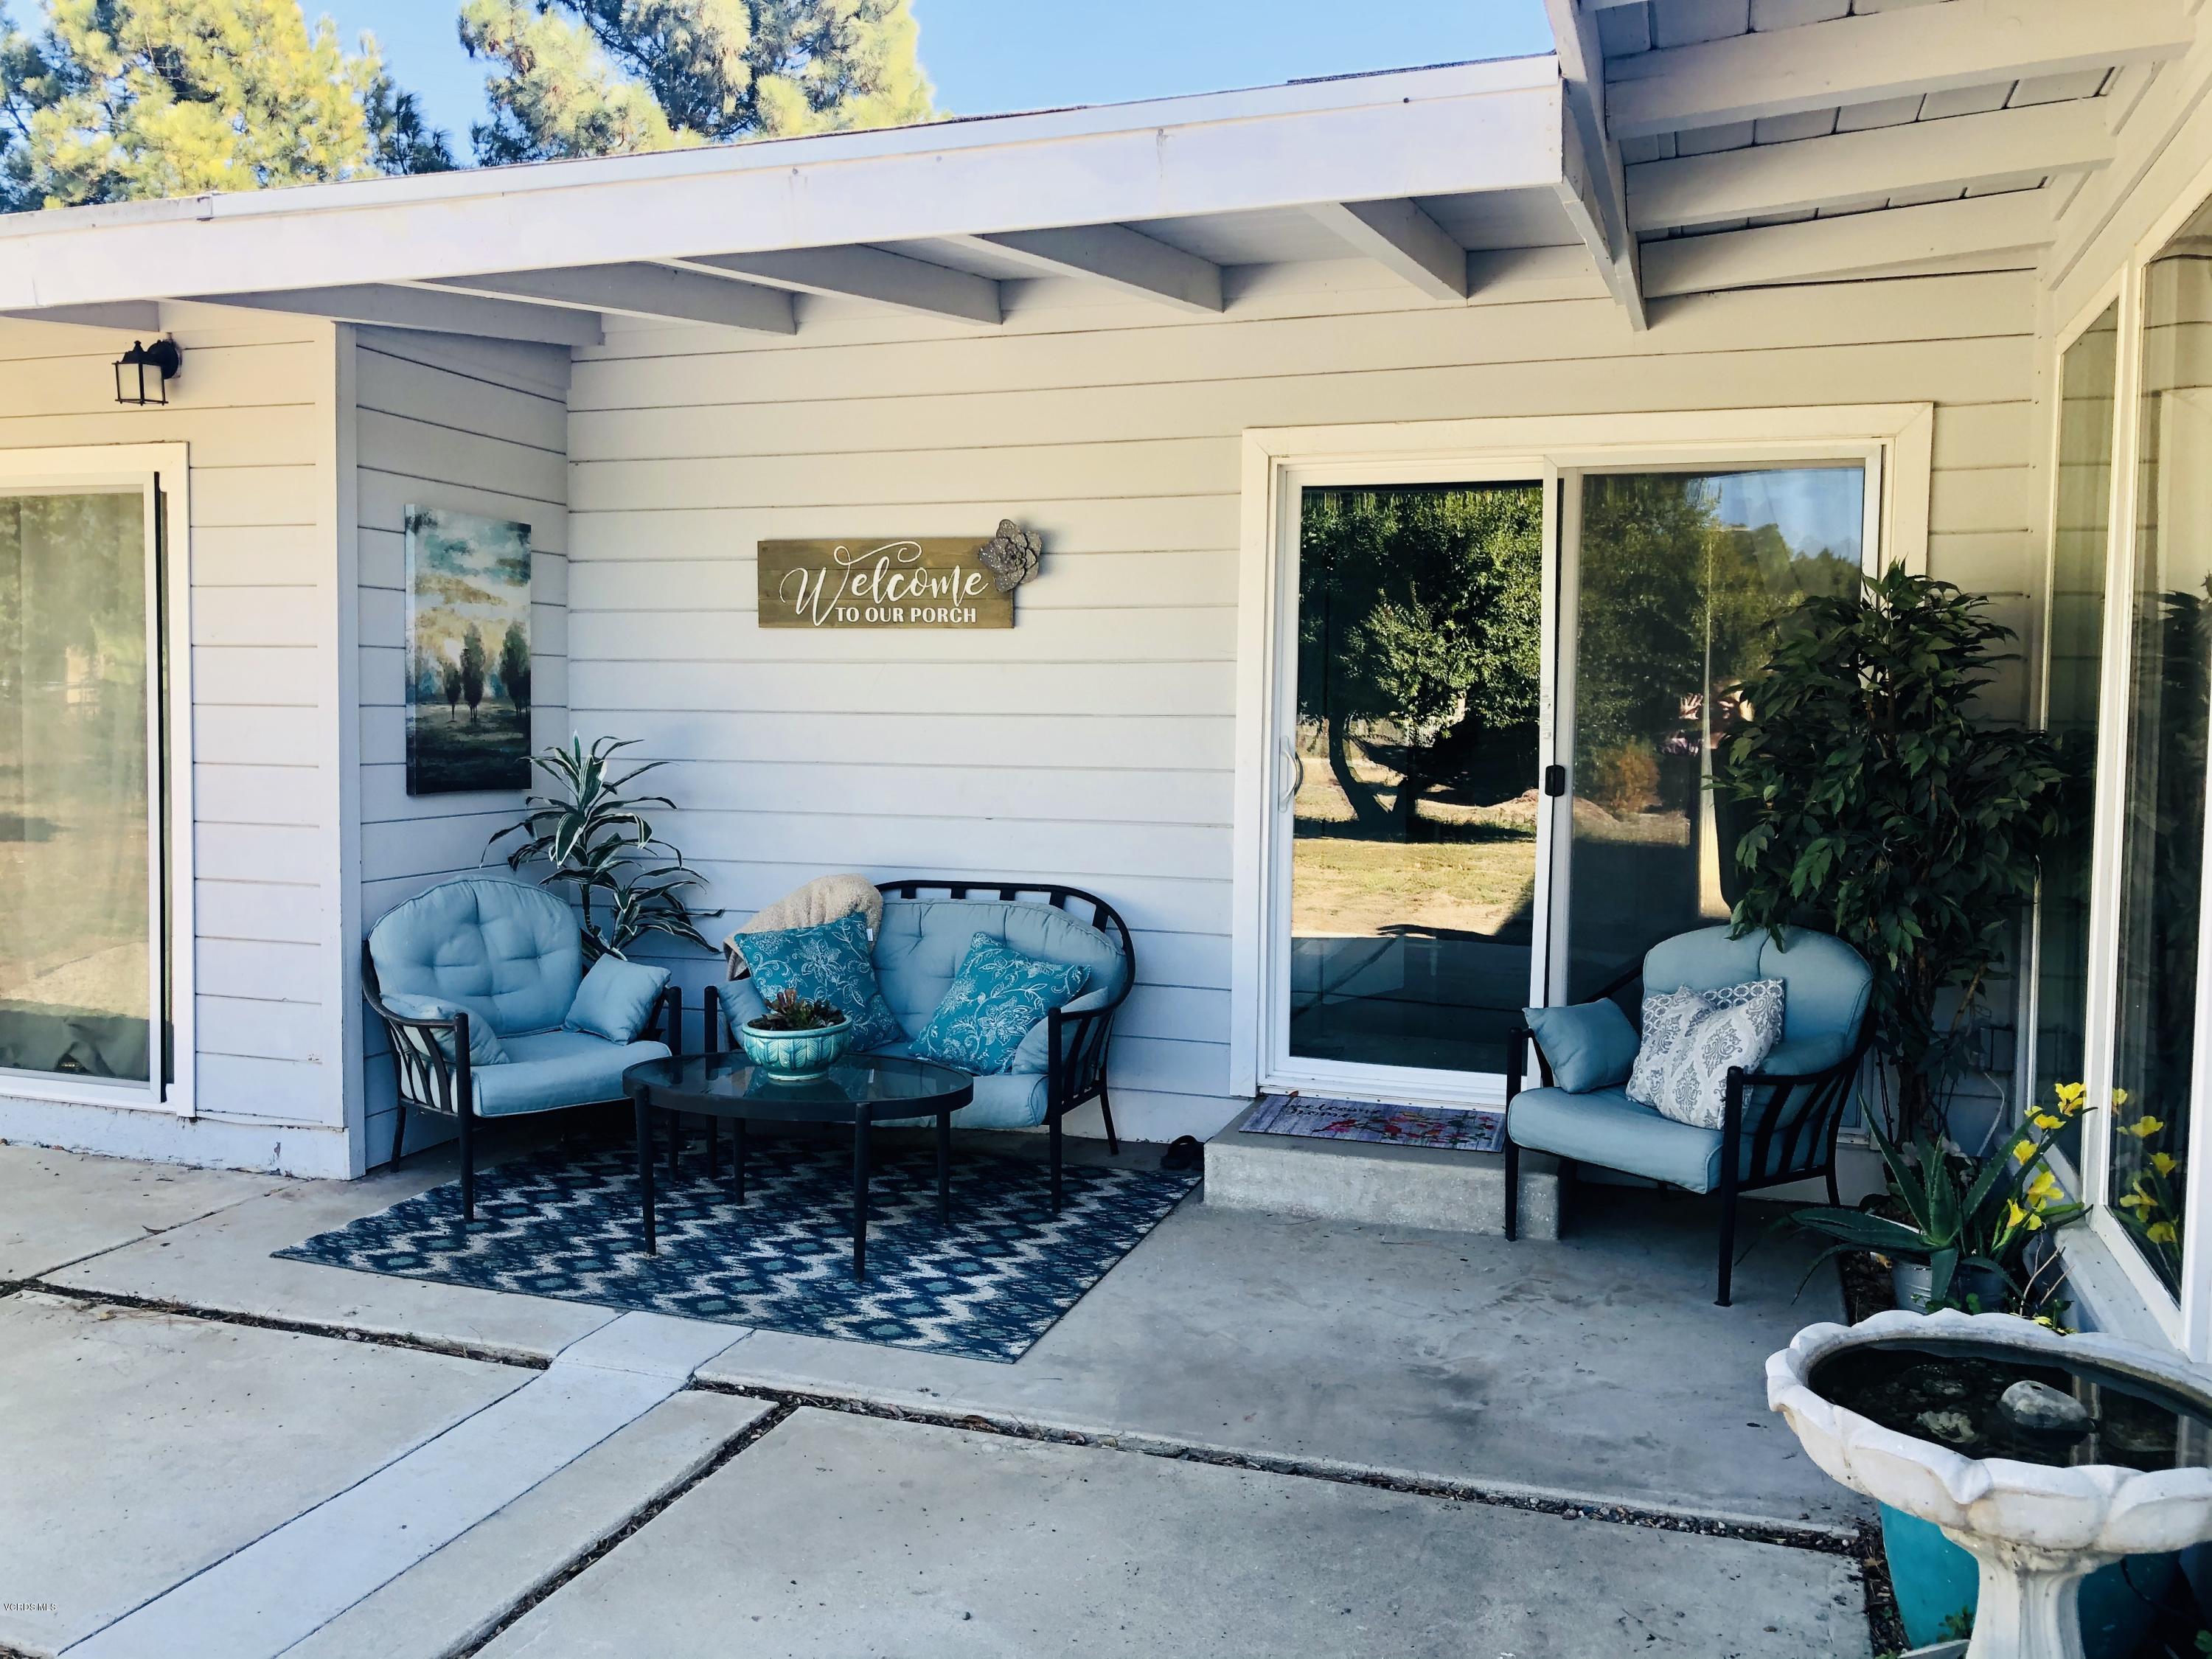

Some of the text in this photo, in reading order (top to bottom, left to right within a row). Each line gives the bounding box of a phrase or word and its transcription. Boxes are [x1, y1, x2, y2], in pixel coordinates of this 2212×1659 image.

[779, 540, 990, 627] Welcome
[835, 607, 977, 623] TO OUR PORCH
